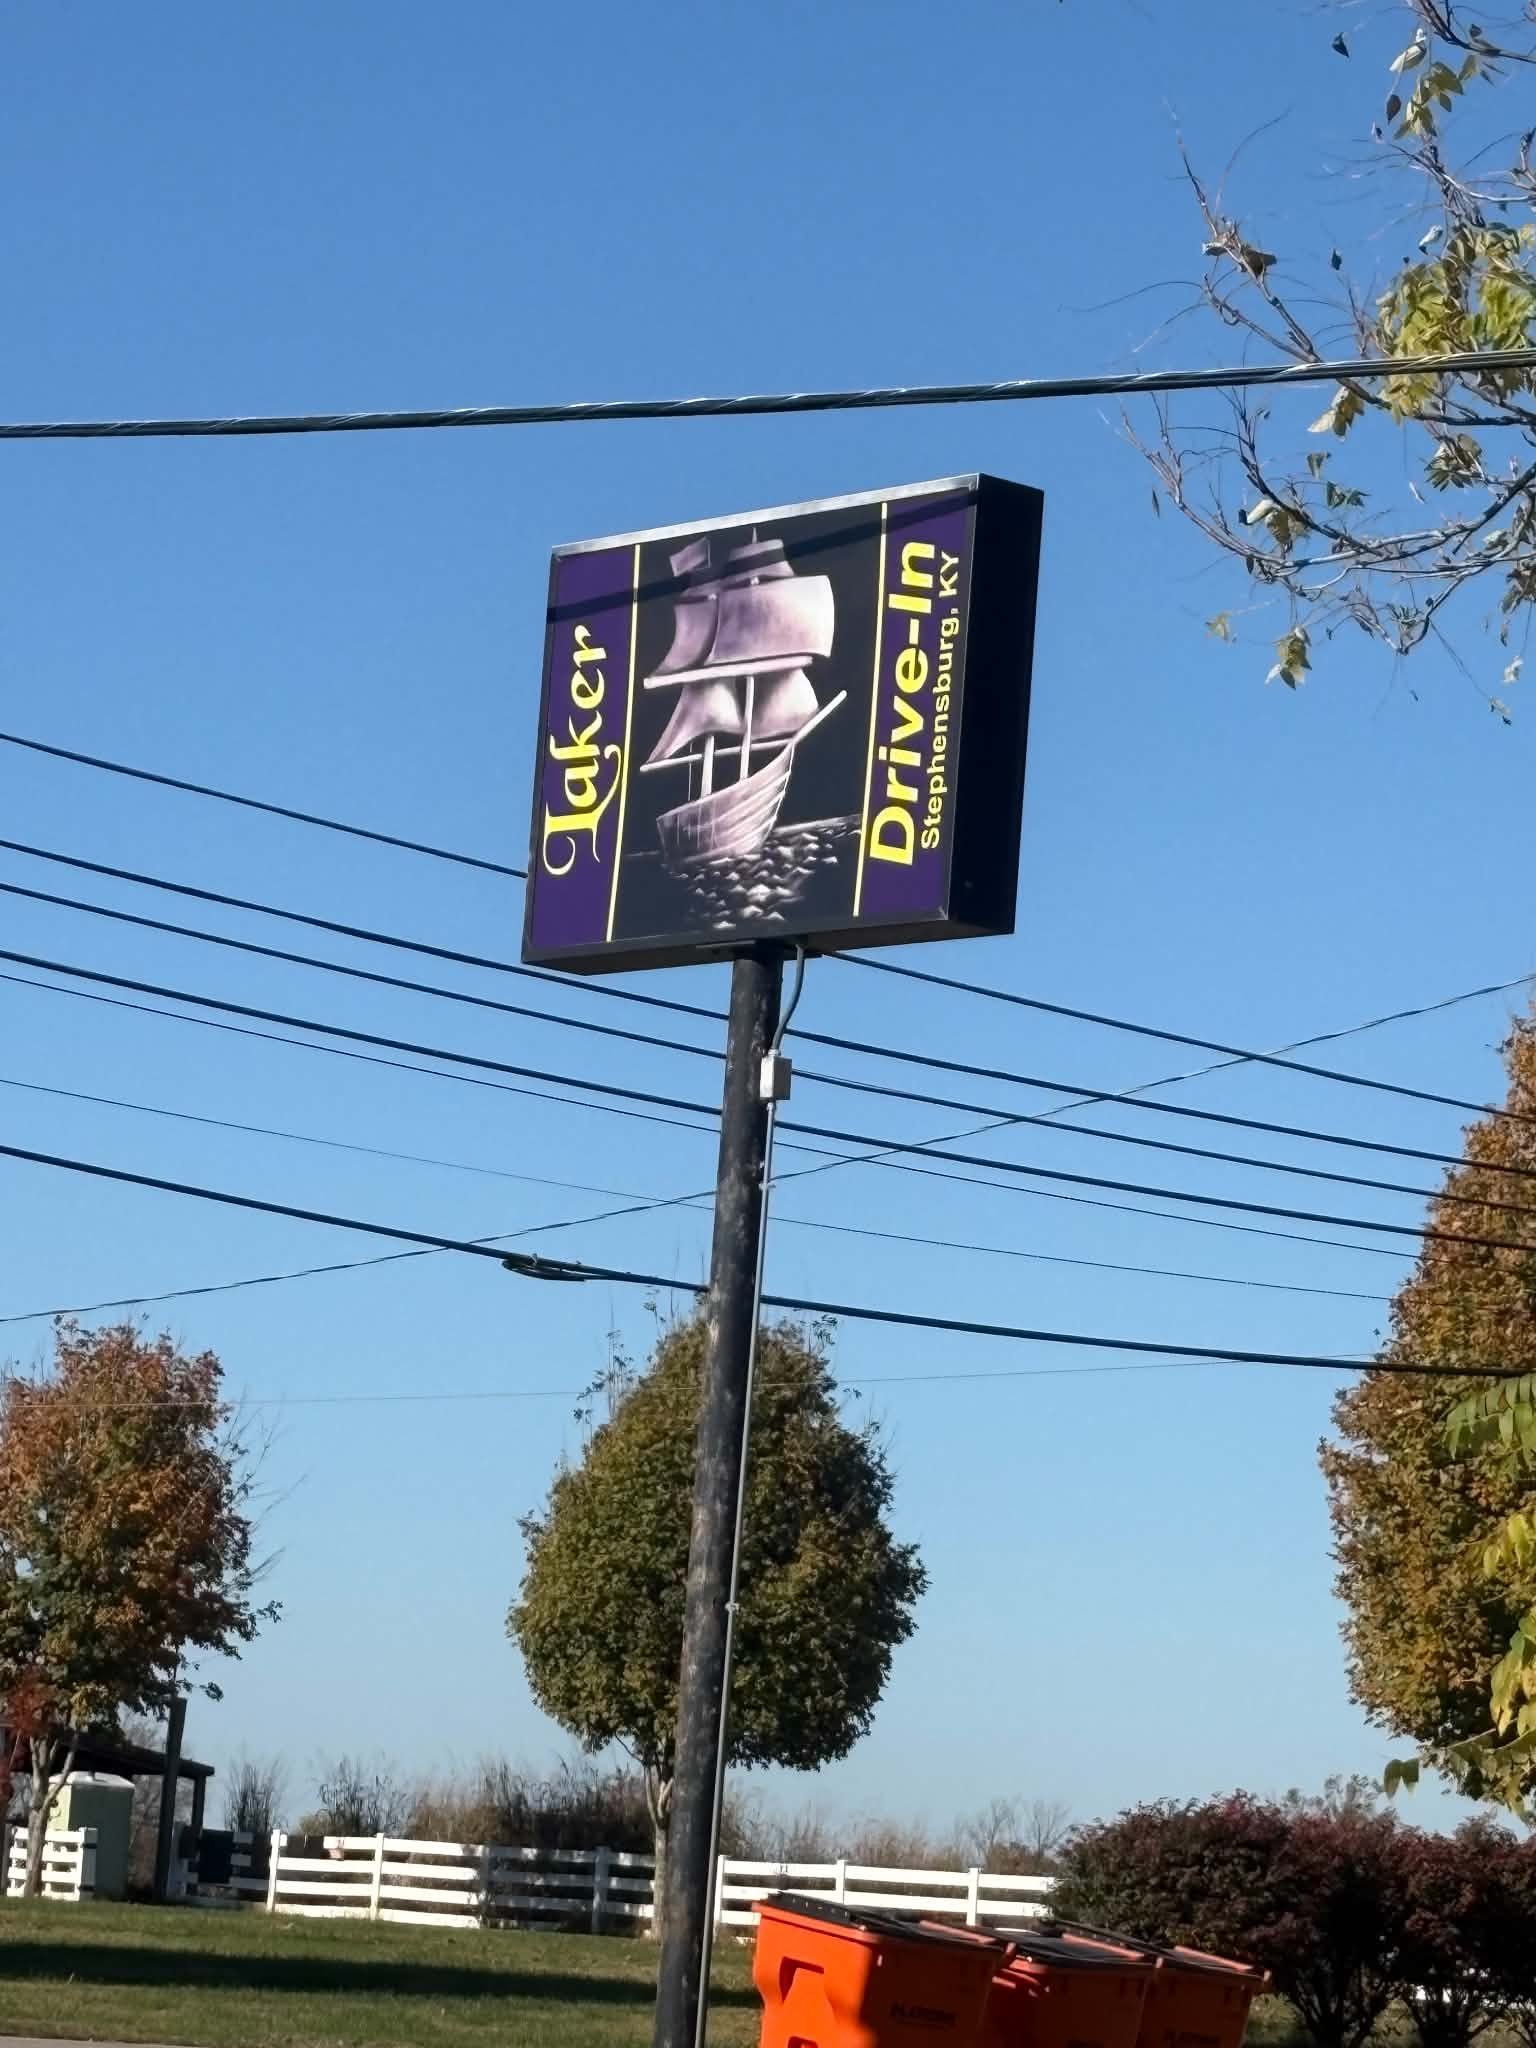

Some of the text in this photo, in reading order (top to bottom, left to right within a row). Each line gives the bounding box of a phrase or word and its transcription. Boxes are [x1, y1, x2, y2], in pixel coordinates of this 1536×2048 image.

[542, 624, 621, 876] Laker
[869, 541, 935, 866] Drive-In
[920, 551, 960, 850] Stephensburg, KY
